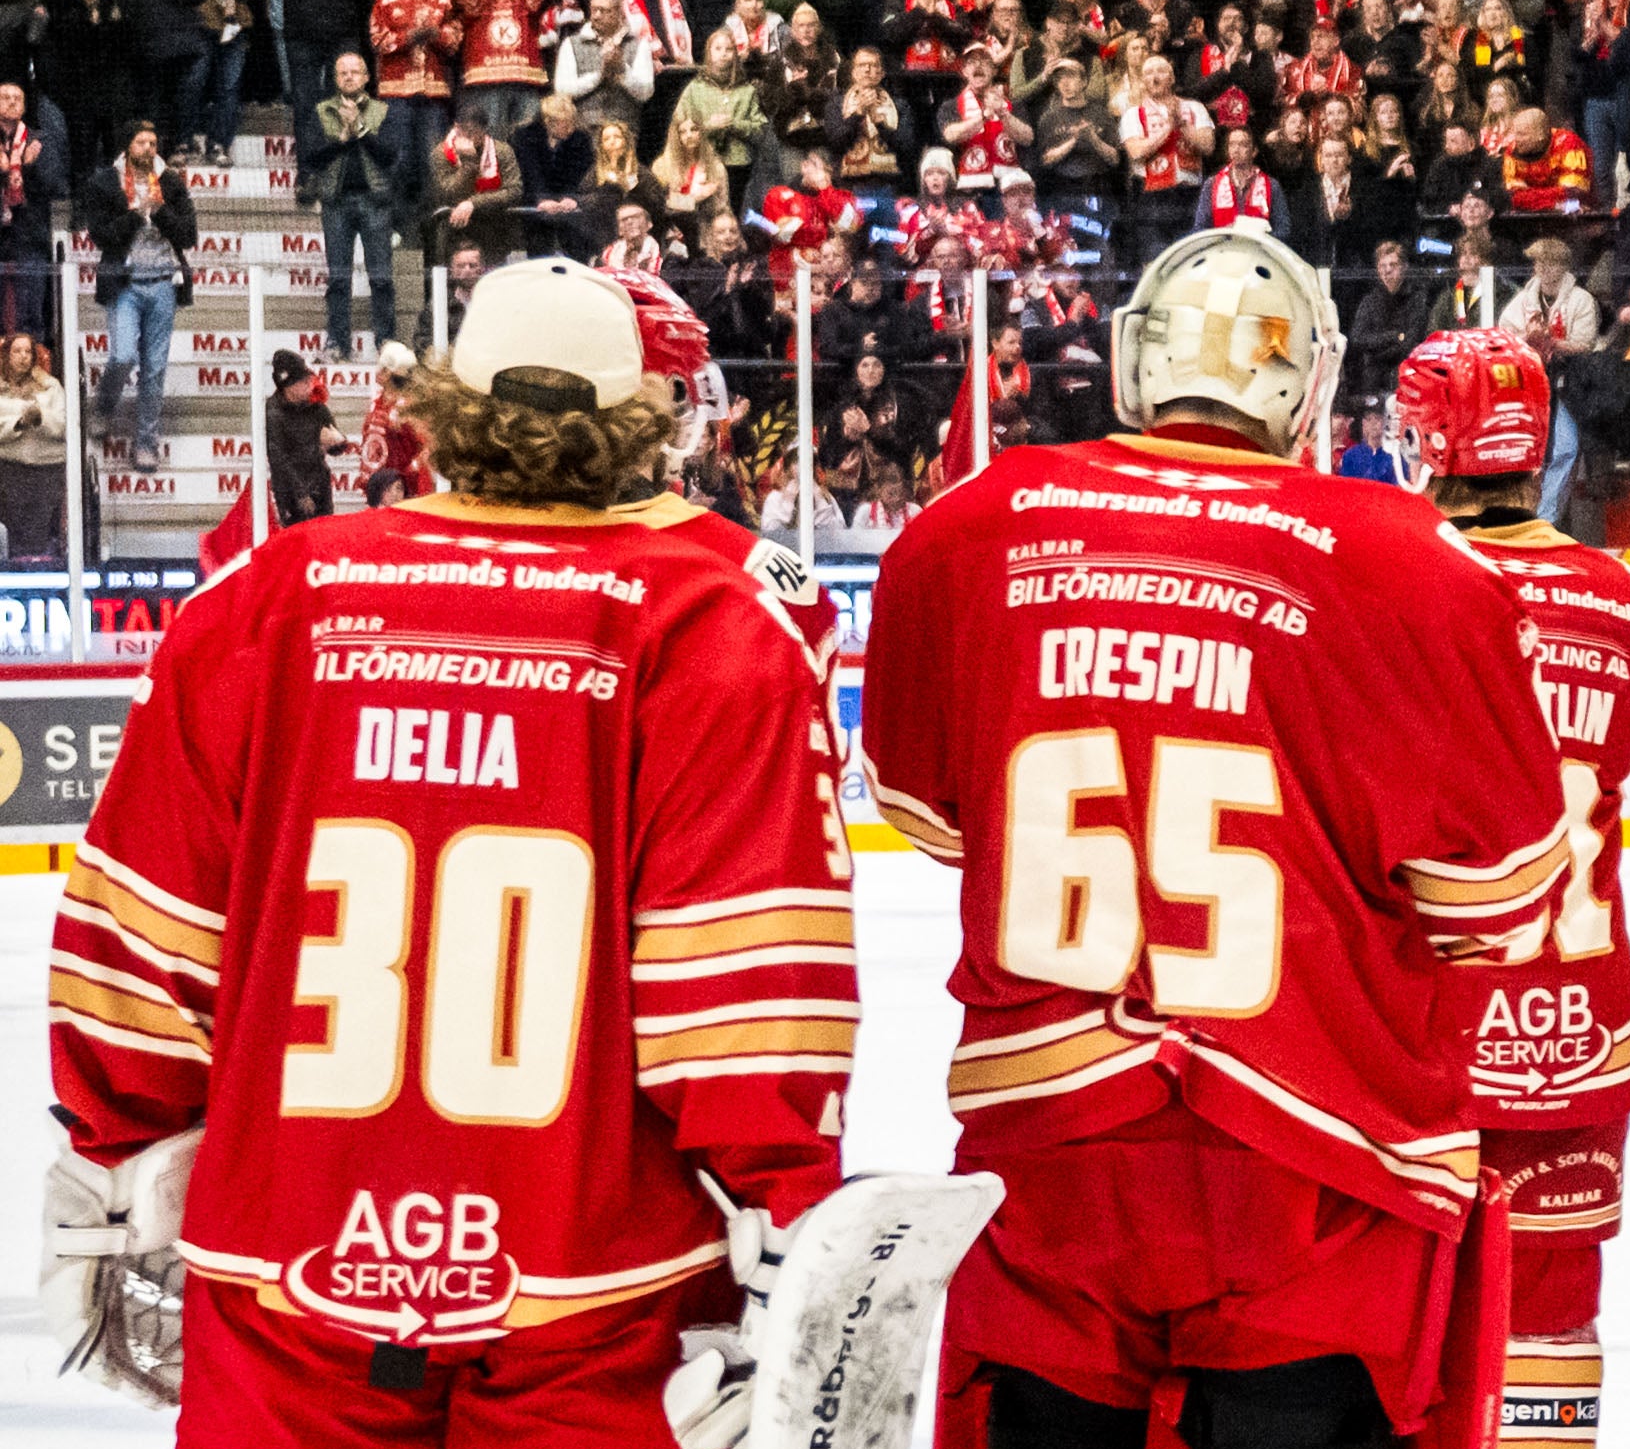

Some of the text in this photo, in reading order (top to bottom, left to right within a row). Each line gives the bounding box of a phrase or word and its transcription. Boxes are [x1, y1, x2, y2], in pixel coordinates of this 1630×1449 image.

[192, 333, 248, 352] MAX
[108, 474, 176, 494] MAXI
[1010, 482, 1339, 555] Calmarsunds Undertak
[305, 557, 648, 606] Calmarsunds Undertak
[1006, 568, 1310, 637] BILFÖRMEDLING AB
[313, 645, 572, 691] ILFÖRMEDLING
[1040, 625, 1253, 715] CRESPIN
[354, 707, 520, 789] DELIA
[998, 727, 1285, 1019] 65
[279, 816, 598, 1128] 30
[1476, 983, 1594, 1037] AGB
[1476, 1034, 1591, 1066] SERVICE
[333, 1189, 500, 1263] AGB
[330, 1260, 493, 1303] SERVICE
[1500, 1397, 1600, 1427] genlokal
